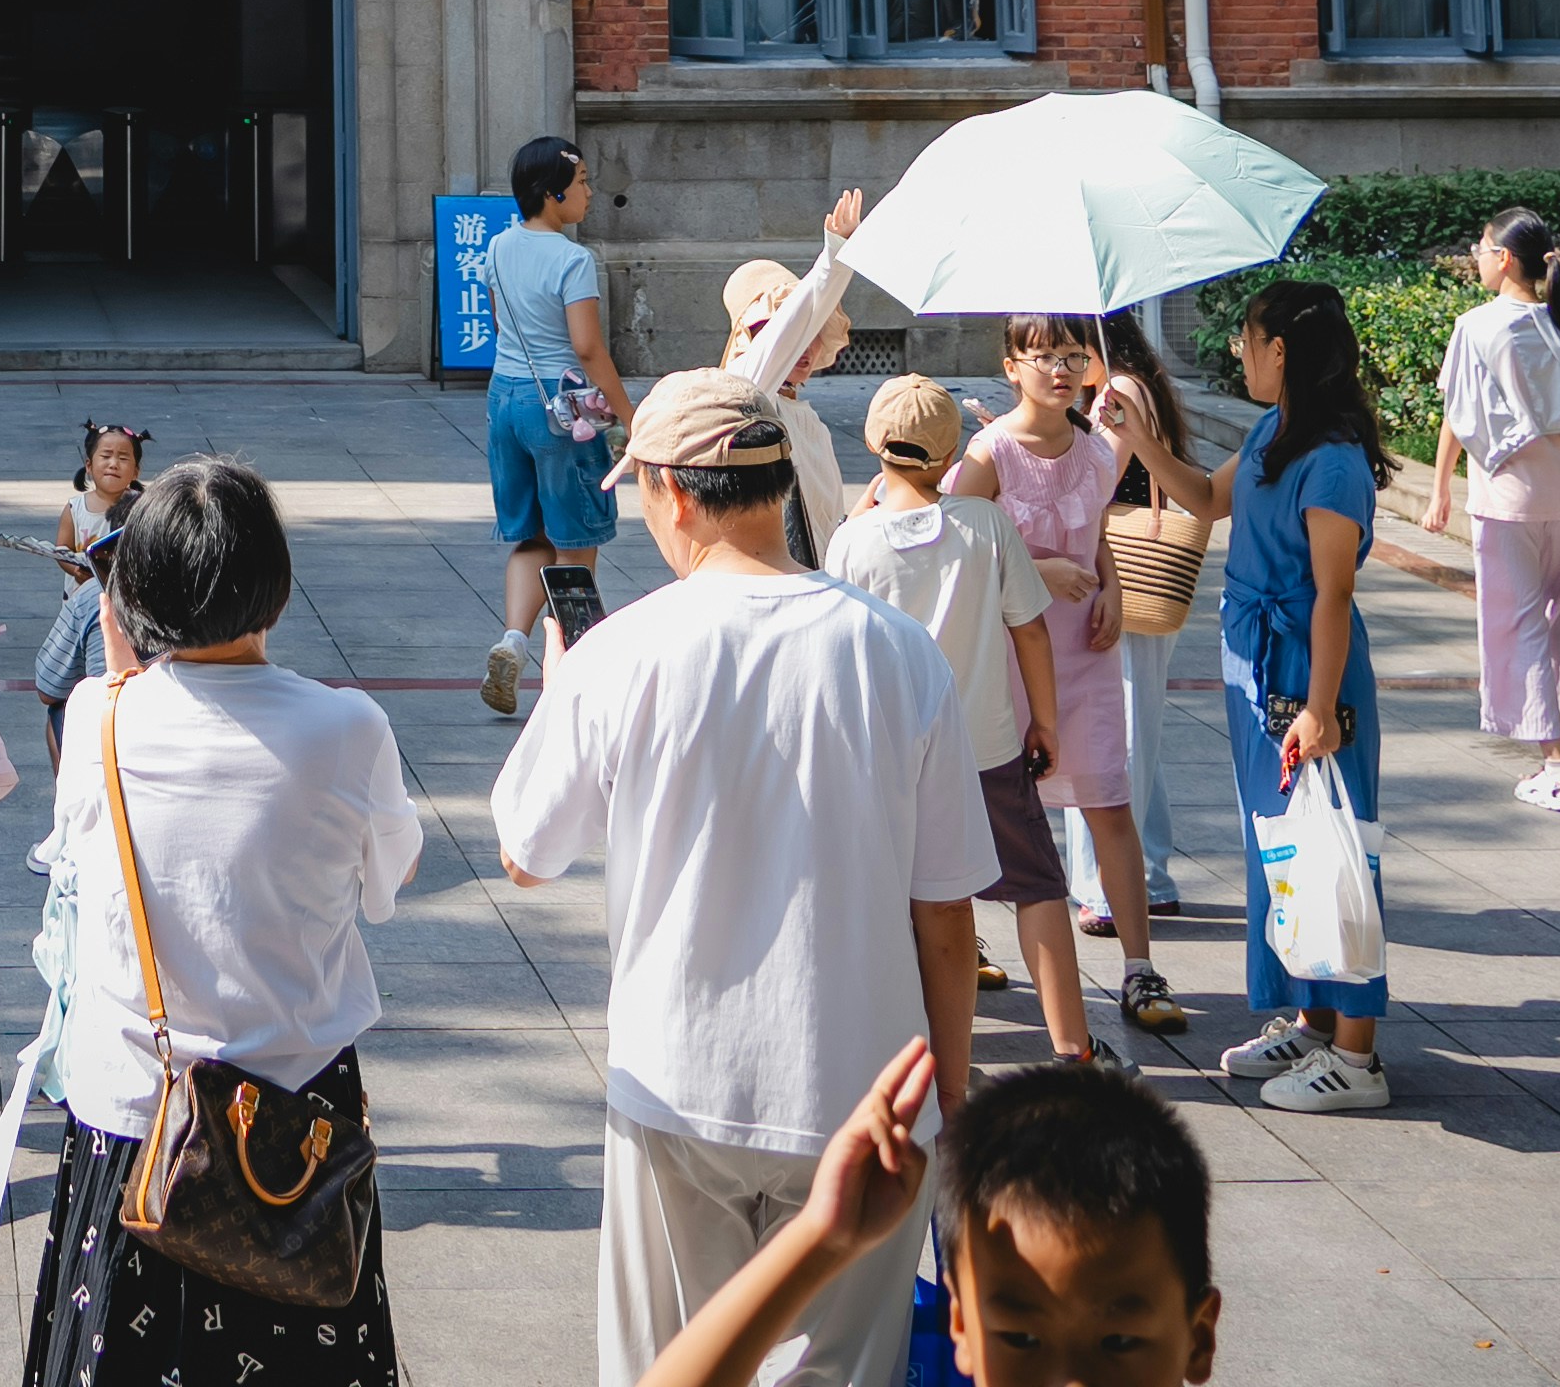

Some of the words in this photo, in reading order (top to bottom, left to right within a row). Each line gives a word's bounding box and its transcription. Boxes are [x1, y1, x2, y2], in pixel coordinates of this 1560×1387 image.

[453, 213, 492, 353] 游客止步
[739, 403, 762, 416] POLO
